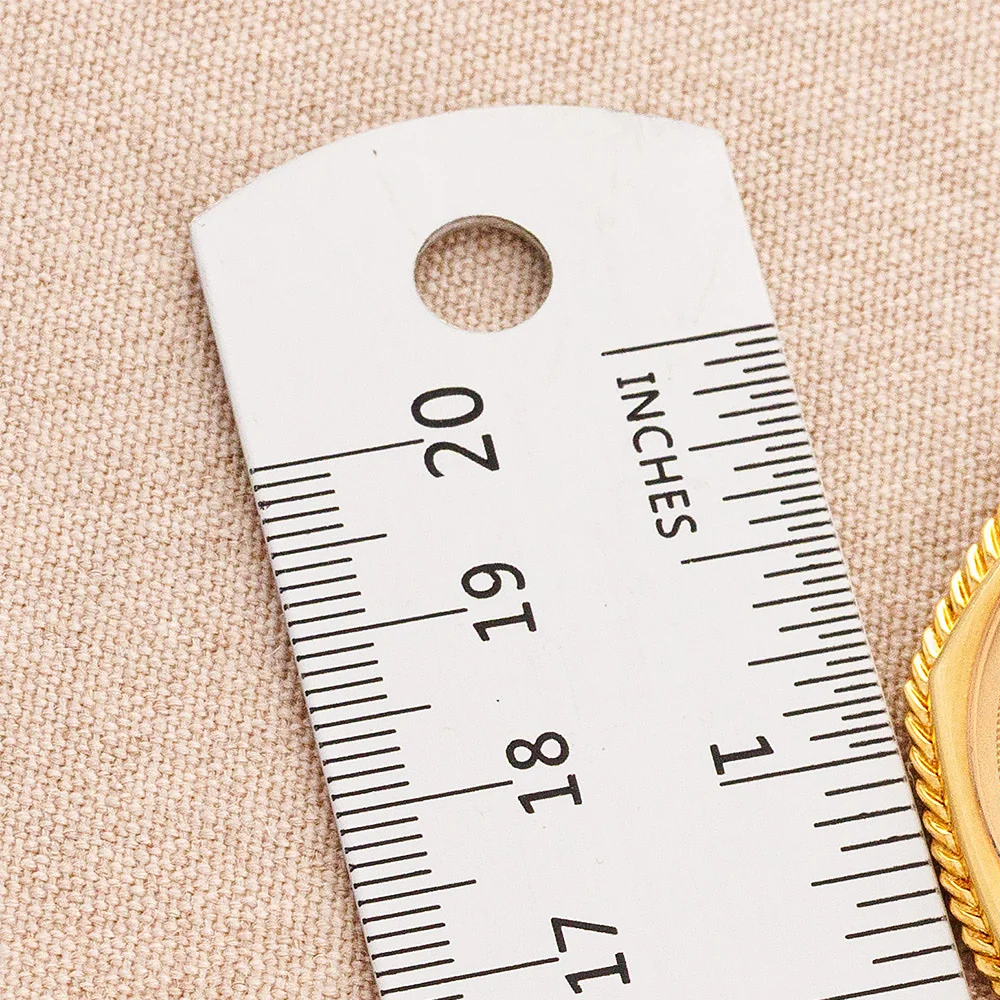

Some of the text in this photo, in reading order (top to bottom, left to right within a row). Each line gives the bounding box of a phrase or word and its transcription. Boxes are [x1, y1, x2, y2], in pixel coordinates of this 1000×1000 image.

[411, 386, 500, 479] 20
[616, 372, 698, 539] INCHES
[463, 561, 538, 642] 19
[506, 731, 582, 815] 18
[709, 735, 774, 775] 1
[551, 917, 631, 994] 17
